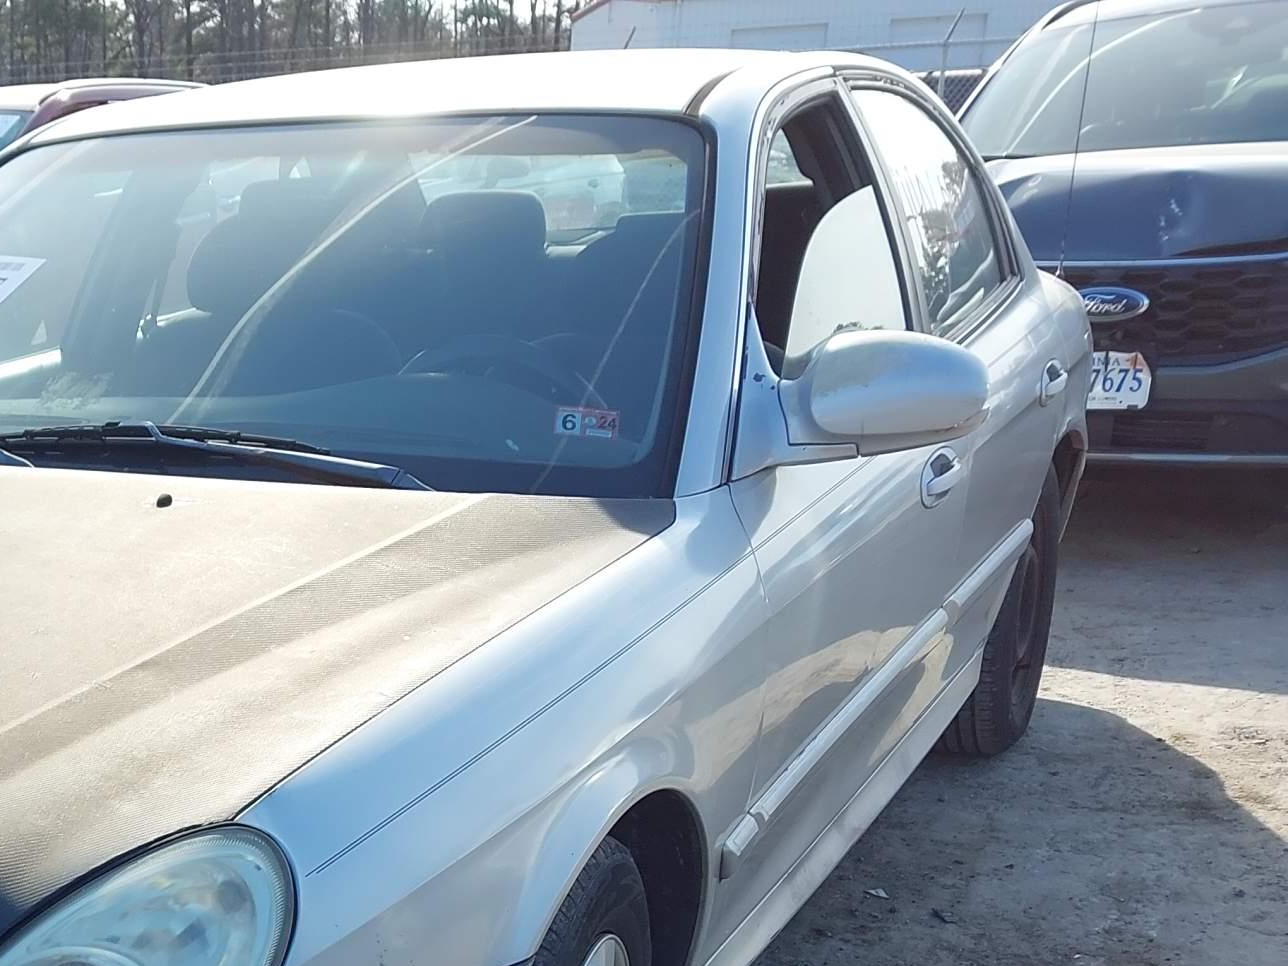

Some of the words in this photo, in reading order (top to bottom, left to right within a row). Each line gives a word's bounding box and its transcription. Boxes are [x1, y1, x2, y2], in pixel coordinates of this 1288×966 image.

[1084, 293, 1128, 313] Ford
[1089, 367, 1144, 393] 7675
[561, 413, 577, 431] 6
[597, 415, 617, 430] 24
